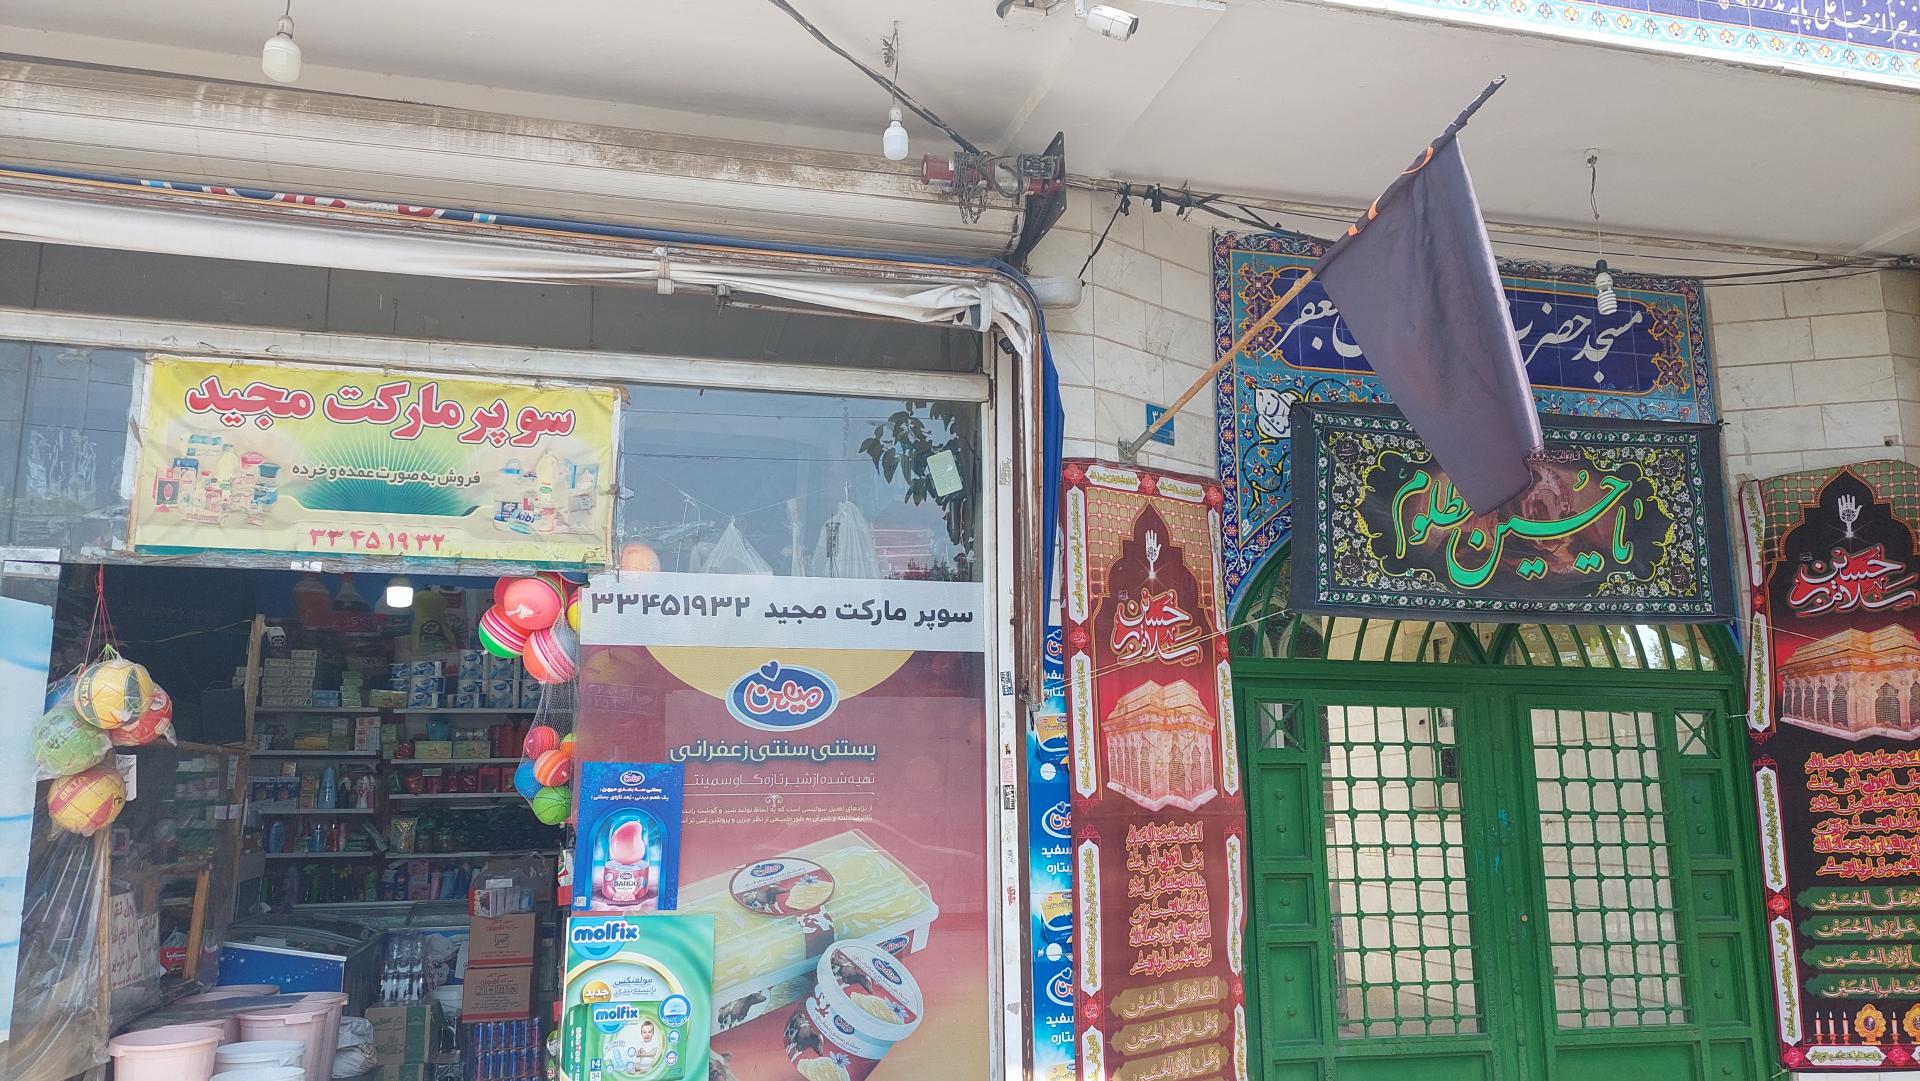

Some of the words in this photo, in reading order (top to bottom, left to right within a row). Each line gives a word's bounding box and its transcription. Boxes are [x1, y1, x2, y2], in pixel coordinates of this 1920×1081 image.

[1261, 300, 1339, 358] عفر
[1571, 311, 1643, 383] مسجد
[186, 375, 314, 430] مجید
[324, 380, 464, 440] مارکت
[292, 464, 328, 478] خرده
[329, 468, 337, 479] و
[338, 467, 374, 478] عمده
[375, 468, 419, 484] صورت
[420, 472, 436, 486] به
[437, 469, 481, 487] فروش
[1391, 470, 1474, 559] ظلوم
[309, 528, 345, 547] ۳۳
[350, 530, 381, 549] ۴۵
[388, 532, 409, 550] ۱۹
[415, 533, 446, 551] ۳۲
[590, 590, 751, 619] ۳۳۴۵۱۹۳۲
[764, 600, 828, 624] مجید
[835, 599, 908, 626] مارکت
[914, 609, 974, 631] سوپر
[744, 679, 824, 715] میهن
[669, 739, 749, 762] زعفرانی
[750, 739, 810, 762] سنتی
[811, 739, 877, 761] بستنی
[683, 773, 733, 789] سمینت
[763, 773, 785, 788] تازه
[784, 771, 812, 789] شیر
[820, 770, 848, 785] شده
[848, 771, 876, 787] تهیه
[573, 922, 639, 942] molfix
[614, 976, 653, 987] مولفیکس
[584, 988, 609, 999] جدید
[595, 1006, 638, 1021] molfix
